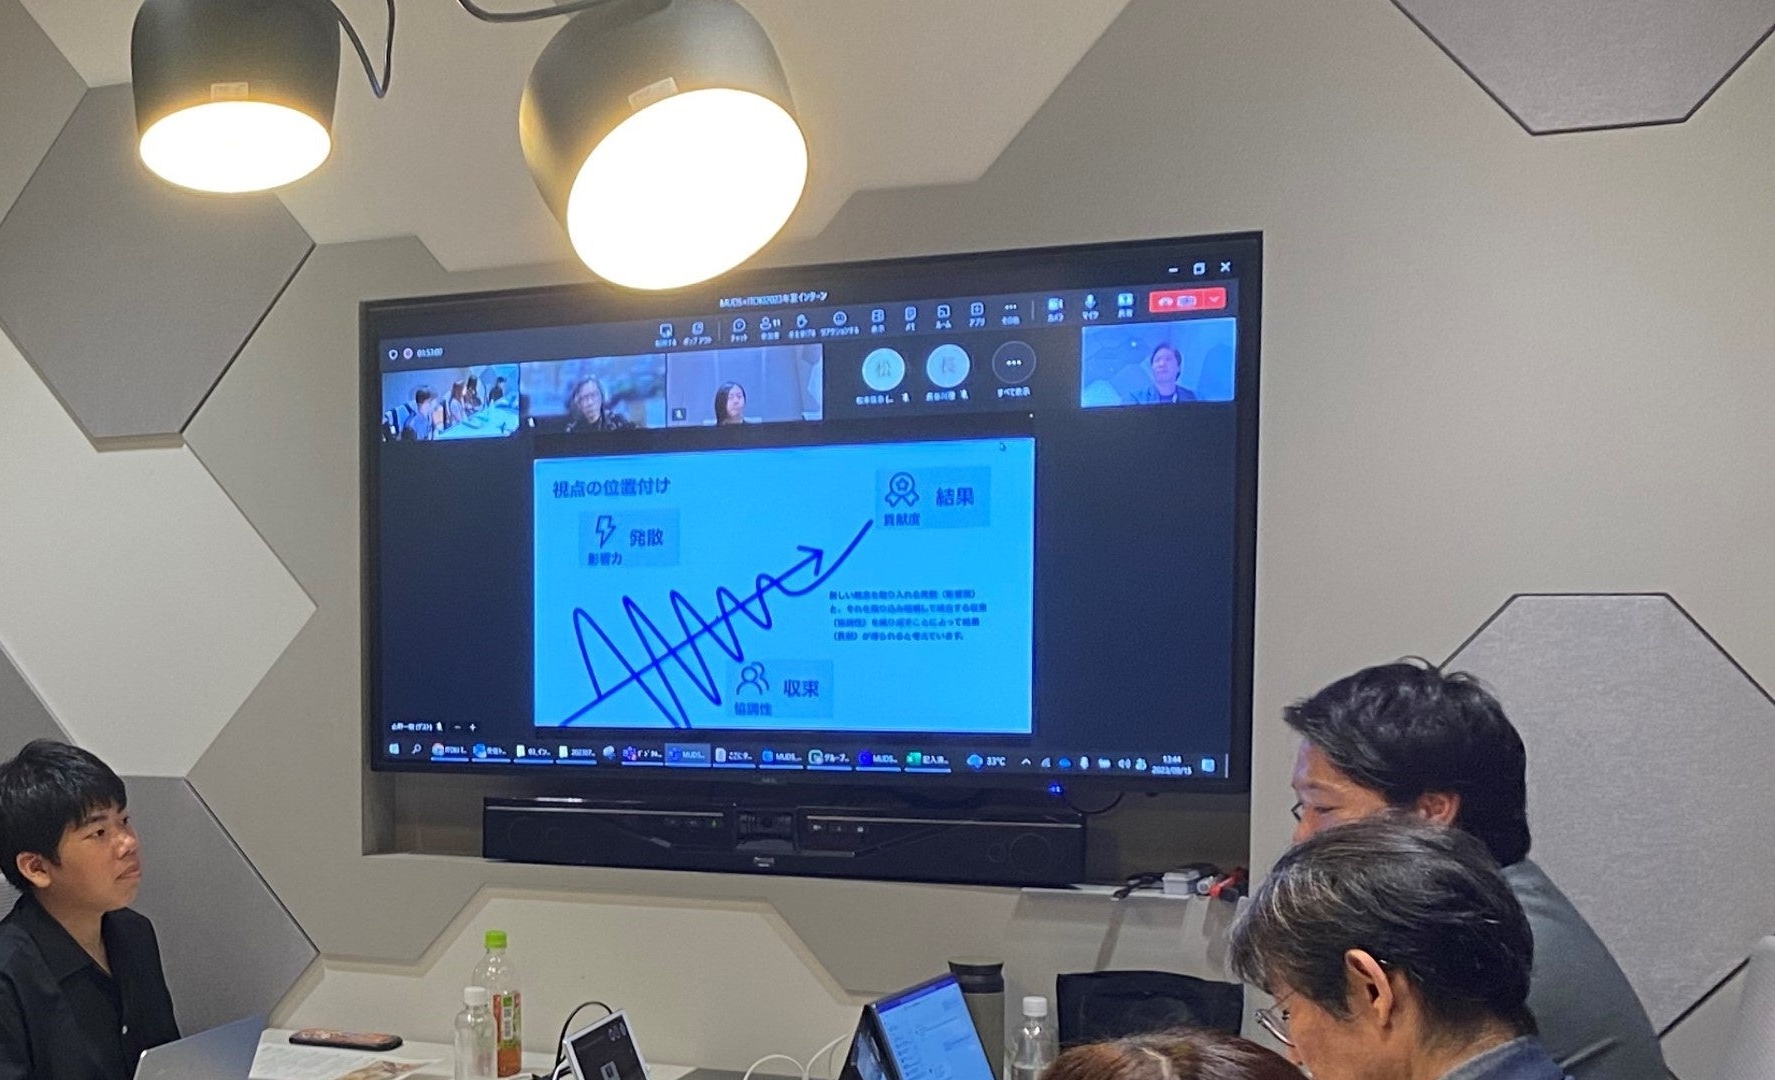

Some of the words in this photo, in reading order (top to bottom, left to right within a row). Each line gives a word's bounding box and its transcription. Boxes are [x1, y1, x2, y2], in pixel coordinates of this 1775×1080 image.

[552, 476, 671, 498] 視点の位置付け
[935, 487, 975, 506] 結果
[629, 529, 664, 547] 発散
[783, 679, 819, 698] 収束
